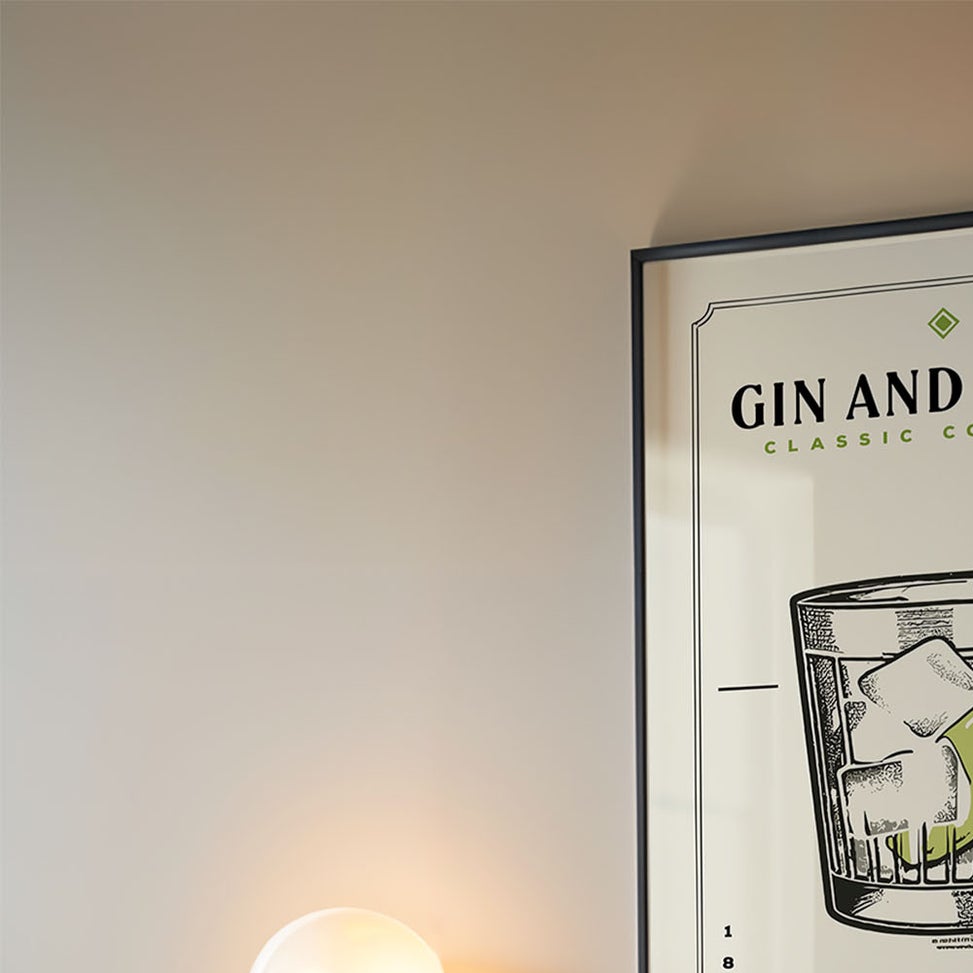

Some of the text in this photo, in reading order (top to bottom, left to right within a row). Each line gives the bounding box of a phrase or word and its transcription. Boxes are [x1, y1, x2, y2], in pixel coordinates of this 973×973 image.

[731, 377, 826, 430] GIN
[845, 366, 963, 421] AND
[763, 429, 913, 454] CLASSIC
